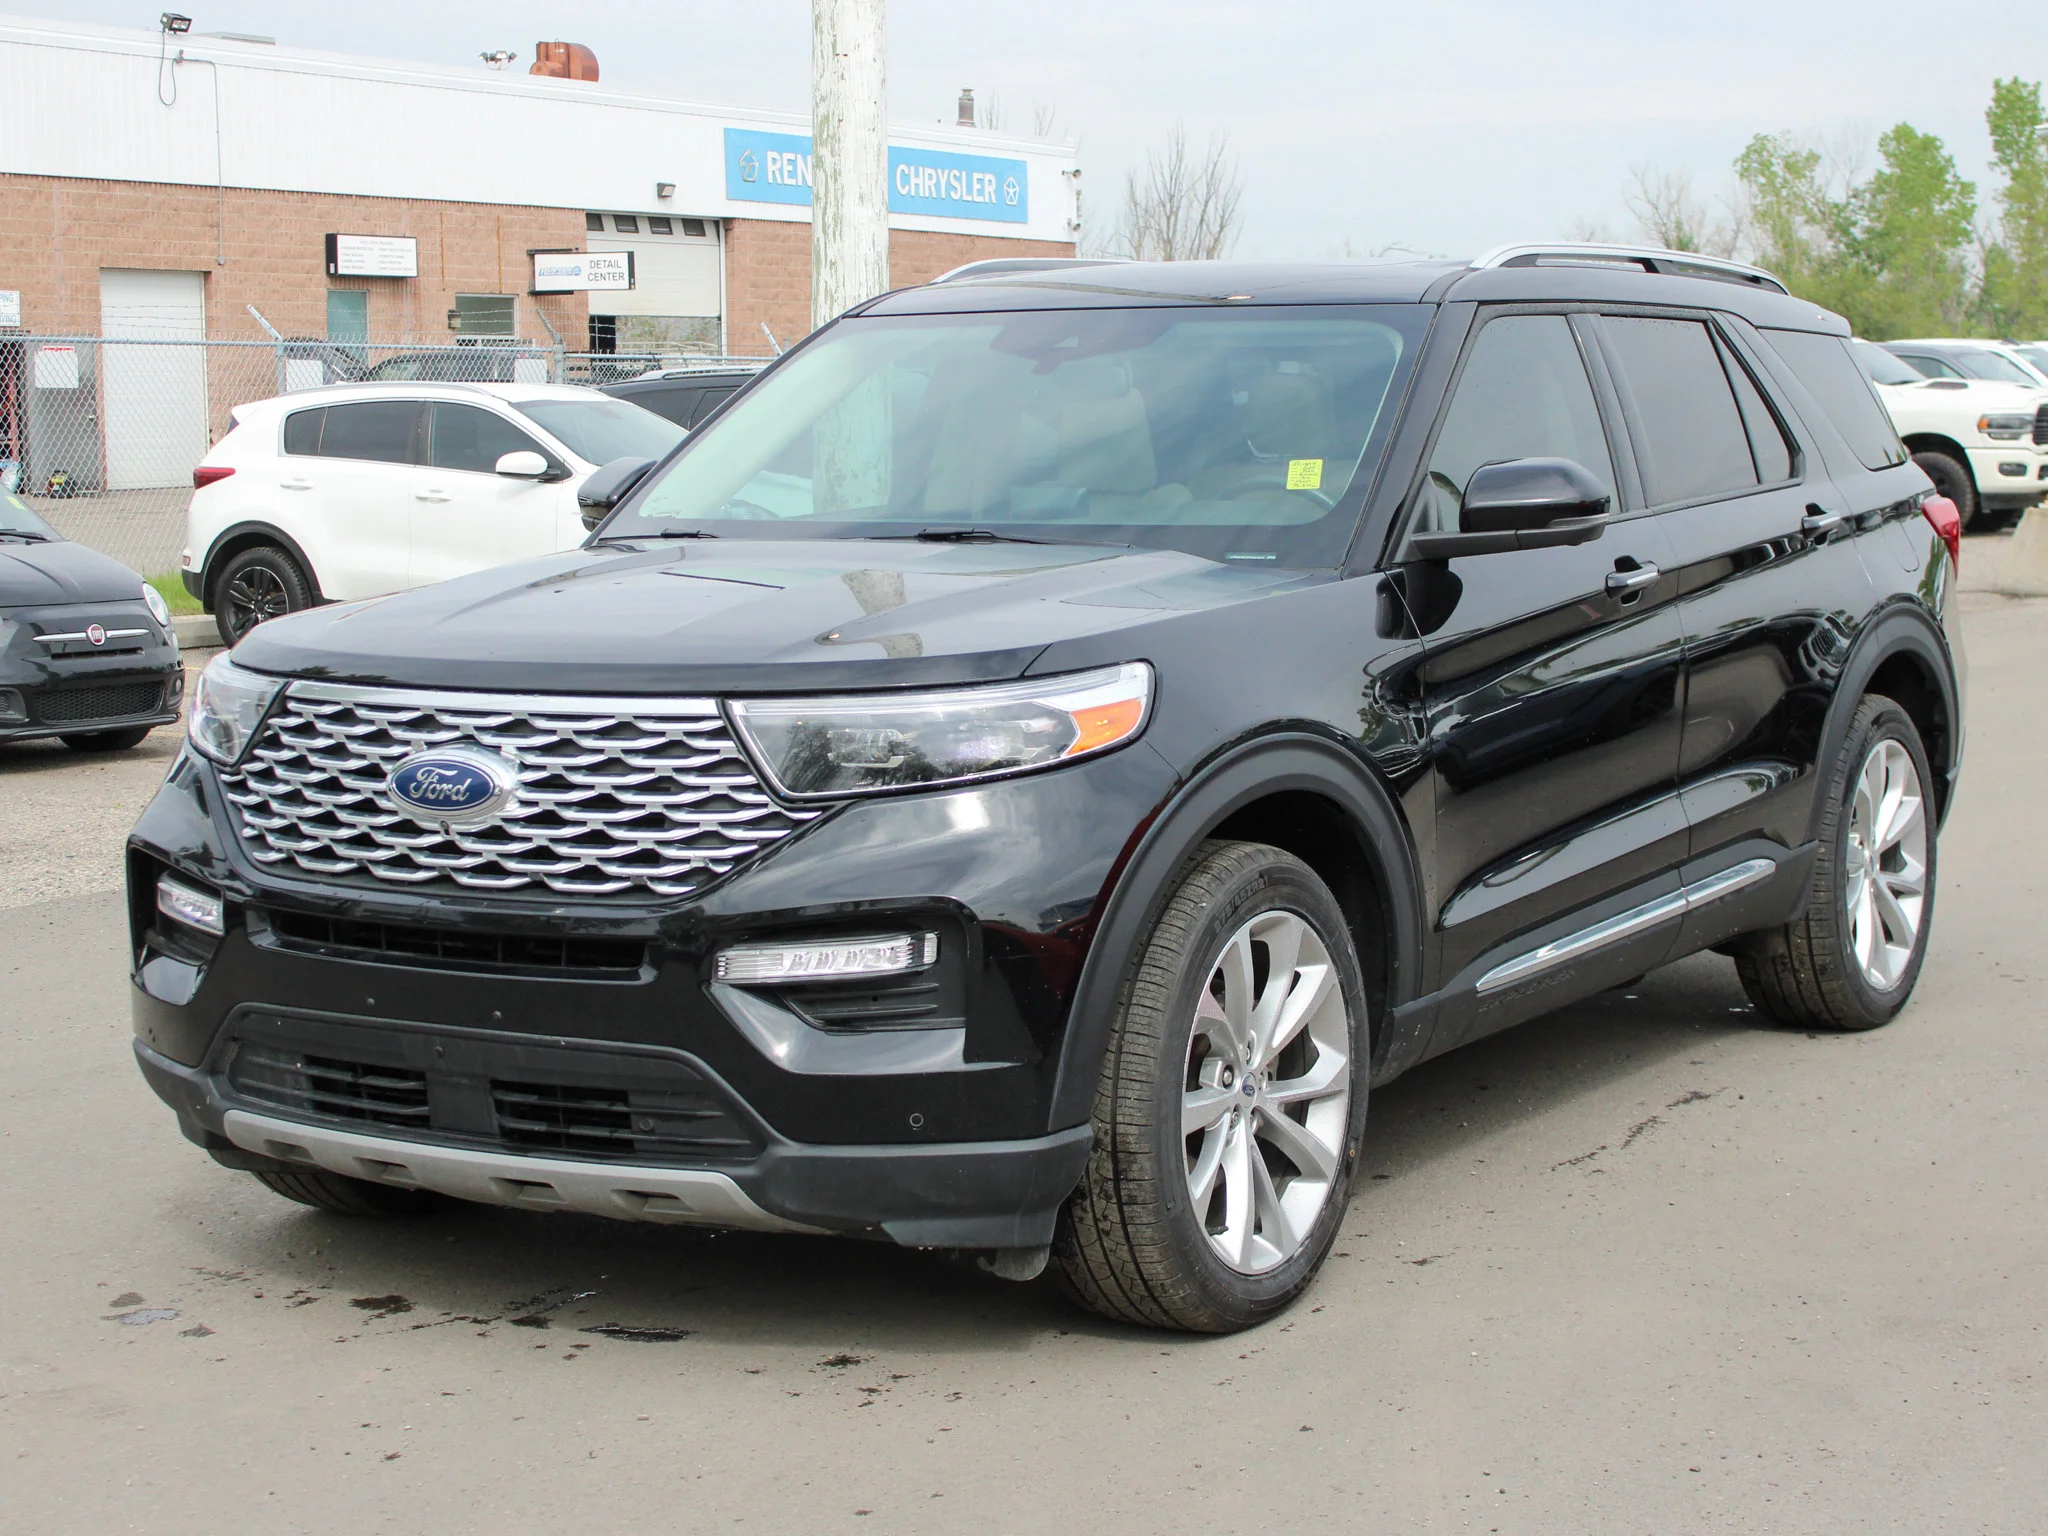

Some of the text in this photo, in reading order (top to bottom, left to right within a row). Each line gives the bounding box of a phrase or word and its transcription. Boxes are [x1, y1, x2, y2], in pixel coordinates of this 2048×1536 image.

[767, 150, 997, 205] REN CHRYSLER
[589, 259, 622, 270] DETAIL
[587, 271, 625, 282] CENTER
[409, 766, 473, 802] Ford
